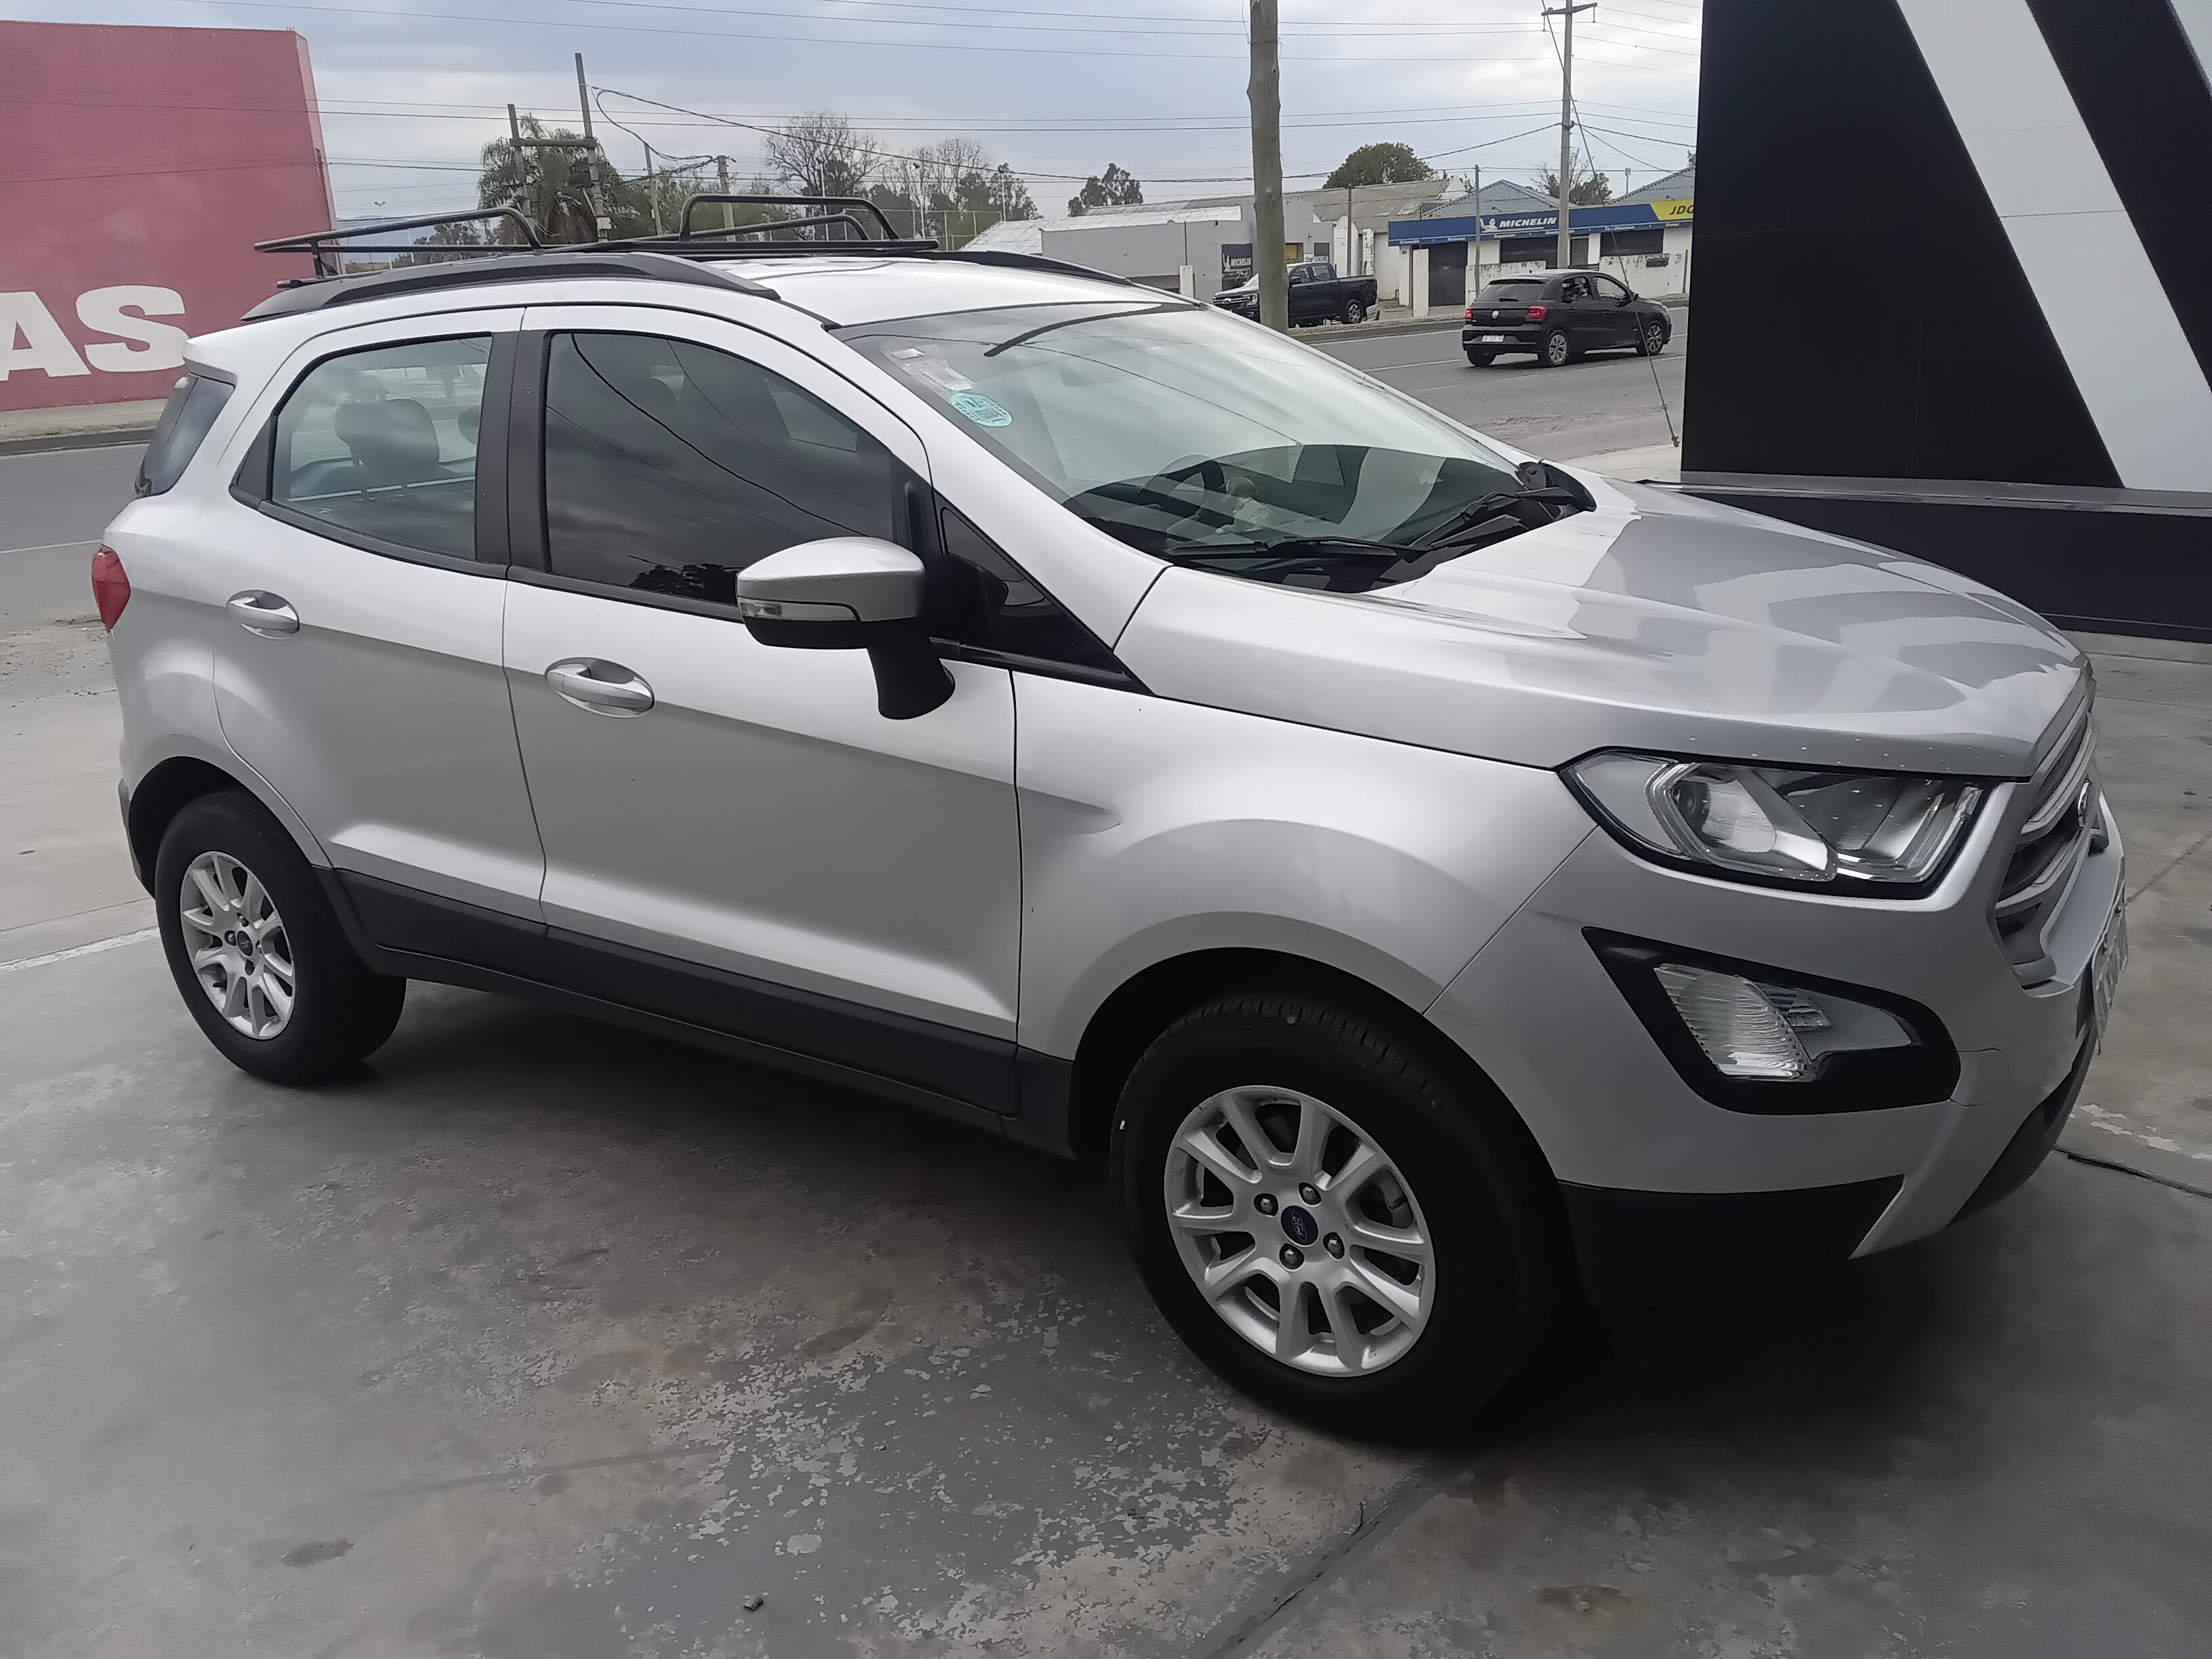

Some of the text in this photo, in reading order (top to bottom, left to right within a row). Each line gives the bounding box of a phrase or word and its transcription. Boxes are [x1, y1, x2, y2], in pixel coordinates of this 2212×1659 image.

[1499, 217, 1557, 228] MICHELIN
[1231, 258, 1252, 266] MICHELIN
[0, 285, 190, 381] AS
[1292, 1216, 1305, 1236] Ford
